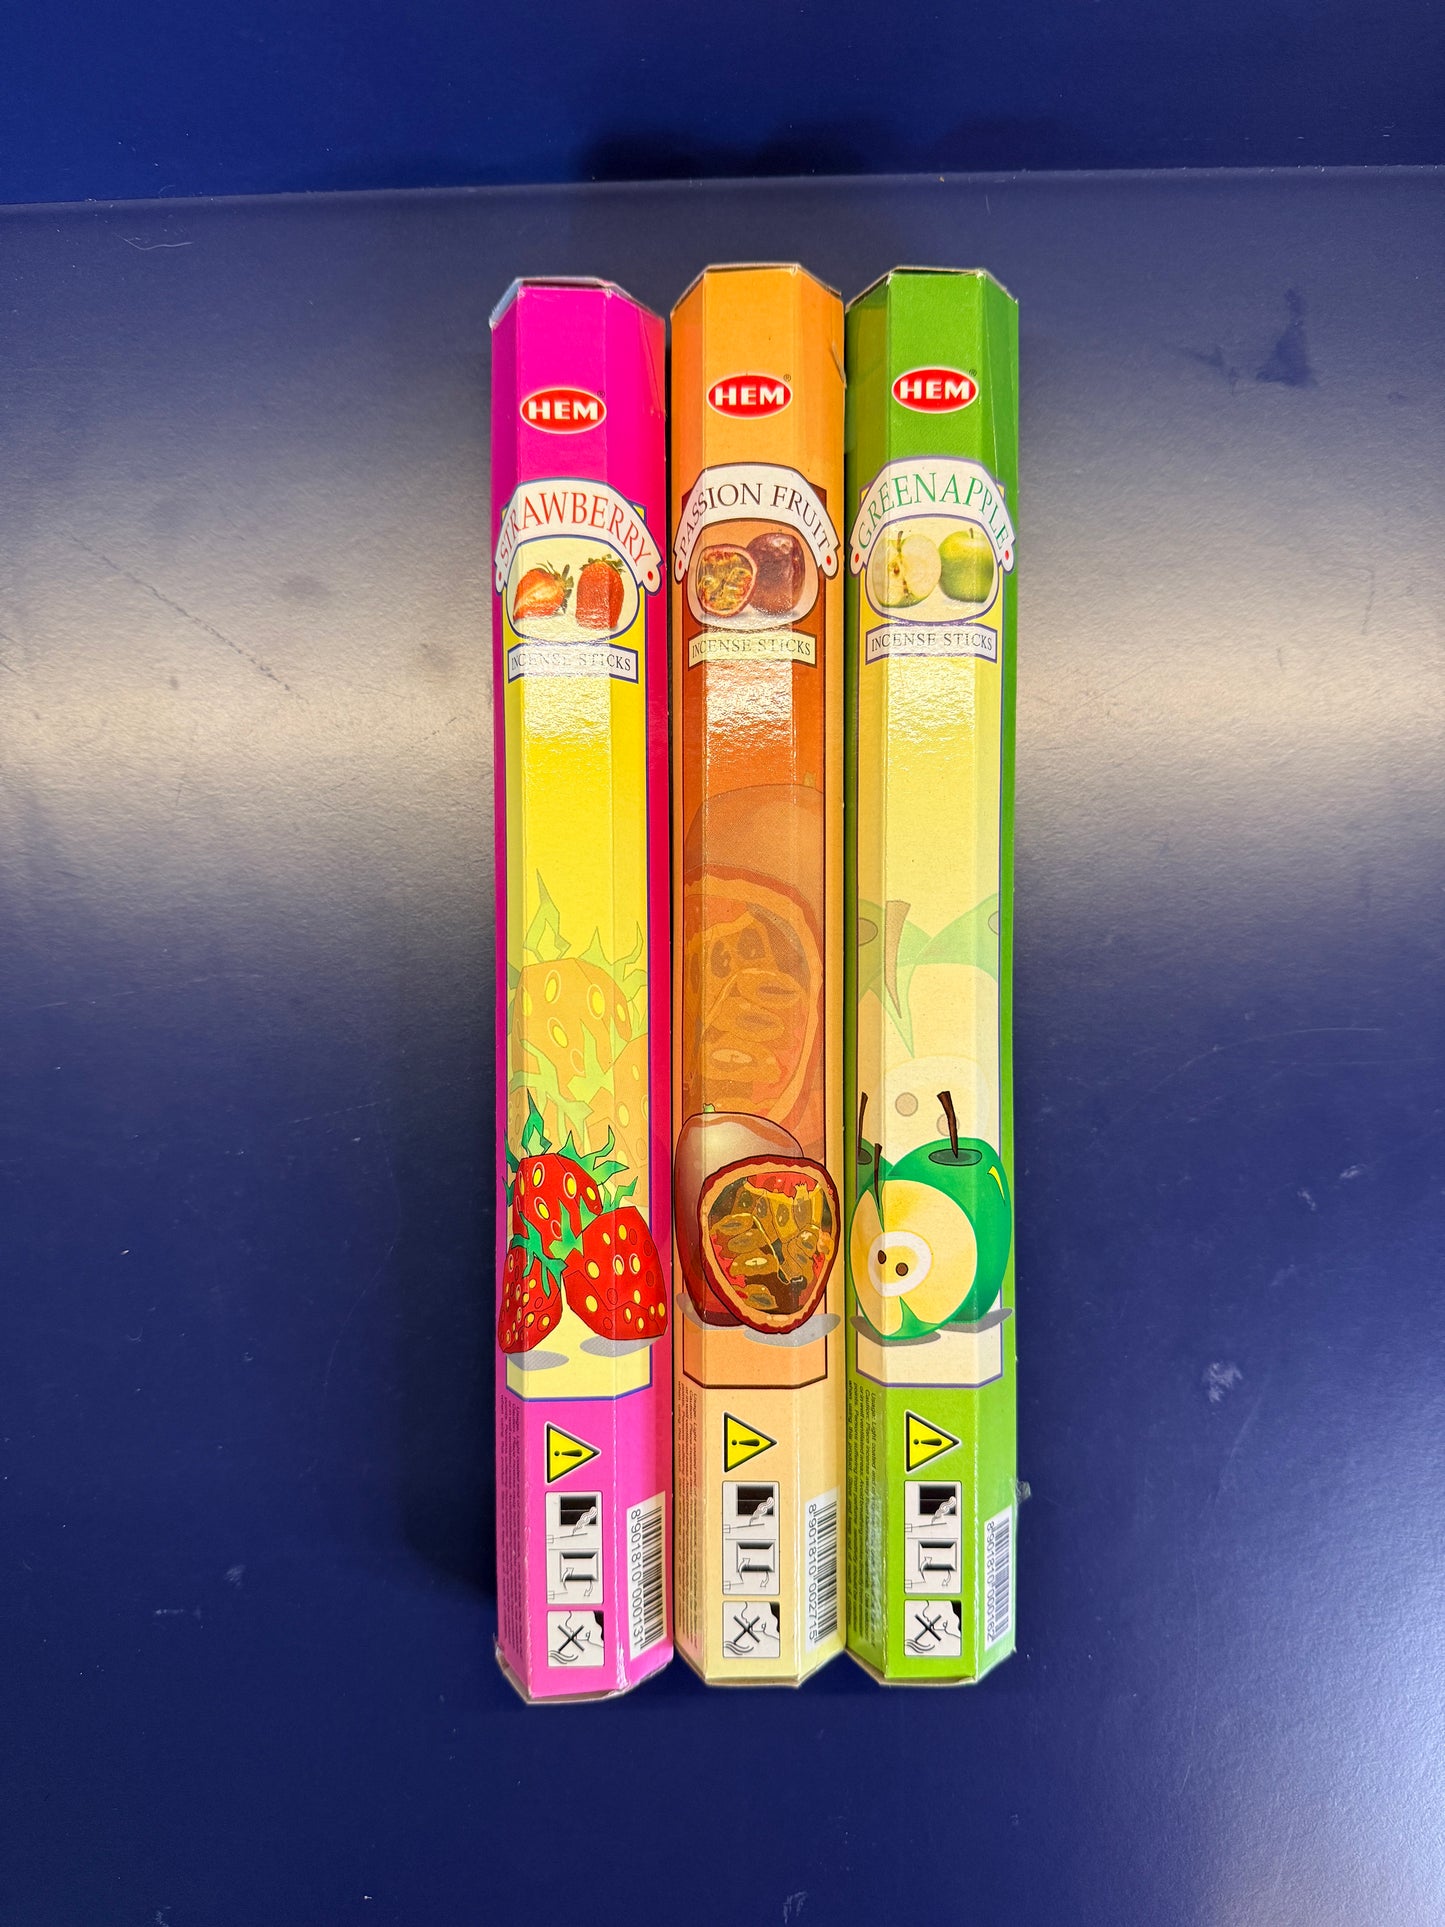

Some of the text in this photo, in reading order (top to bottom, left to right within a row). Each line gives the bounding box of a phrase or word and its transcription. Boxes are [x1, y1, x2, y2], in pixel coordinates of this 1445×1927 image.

[715, 384, 785, 406] HEM
[900, 378, 970, 400] HEM
[528, 399, 599, 421] HEM
[500, 491, 651, 568] STRAWBERRY
[679, 482, 831, 557] PASSION FRUIT
[692, 639, 811, 658] INCENSE STICKS
[871, 633, 993, 652] INCENSE STICKS
[631, 1508, 641, 1520] 8
[808, 1503, 817, 1514] 8
